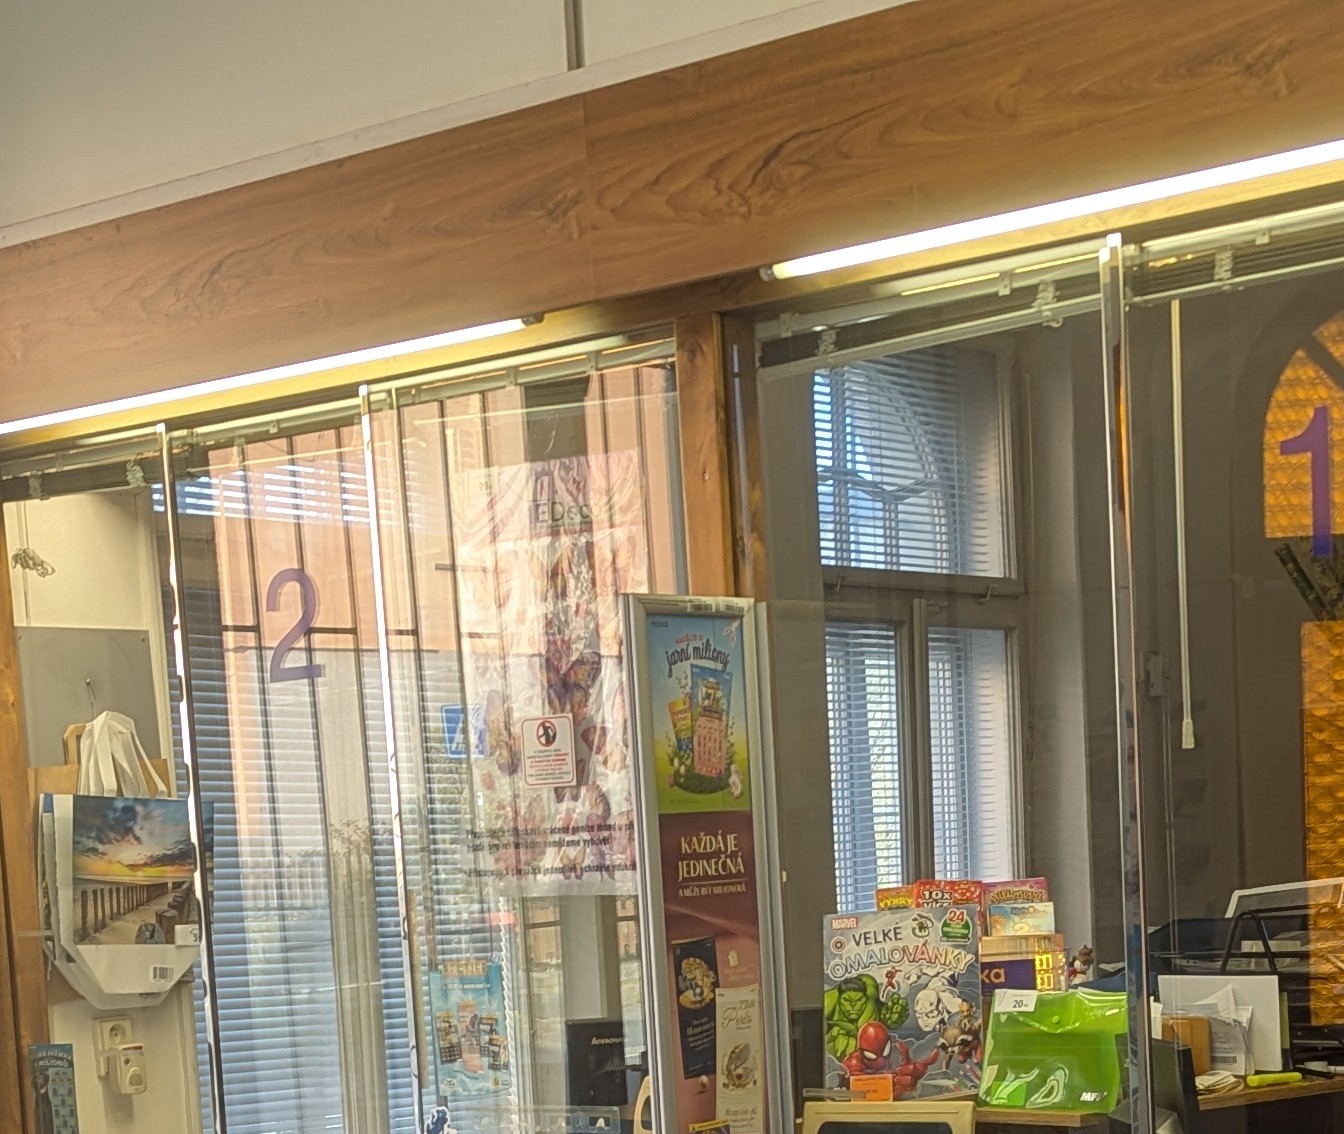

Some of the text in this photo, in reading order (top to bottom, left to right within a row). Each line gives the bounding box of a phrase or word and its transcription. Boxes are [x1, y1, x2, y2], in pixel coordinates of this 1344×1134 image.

[1278, 404, 1334, 558] 1
[265, 567, 325, 683] 2
[693, 638, 730, 673] miliony
[681, 830, 739, 855] KAŽDÁ JE
[678, 852, 745, 882] JEDINEČNÁ
[922, 889, 952, 900] 10x
[831, 918, 858, 930] MARVEL
[948, 909, 966, 923] 24
[852, 922, 903, 947] VELKÉ
[830, 939, 975, 980] OMALOVÁNKY
[1012, 999, 1024, 1009] 20
